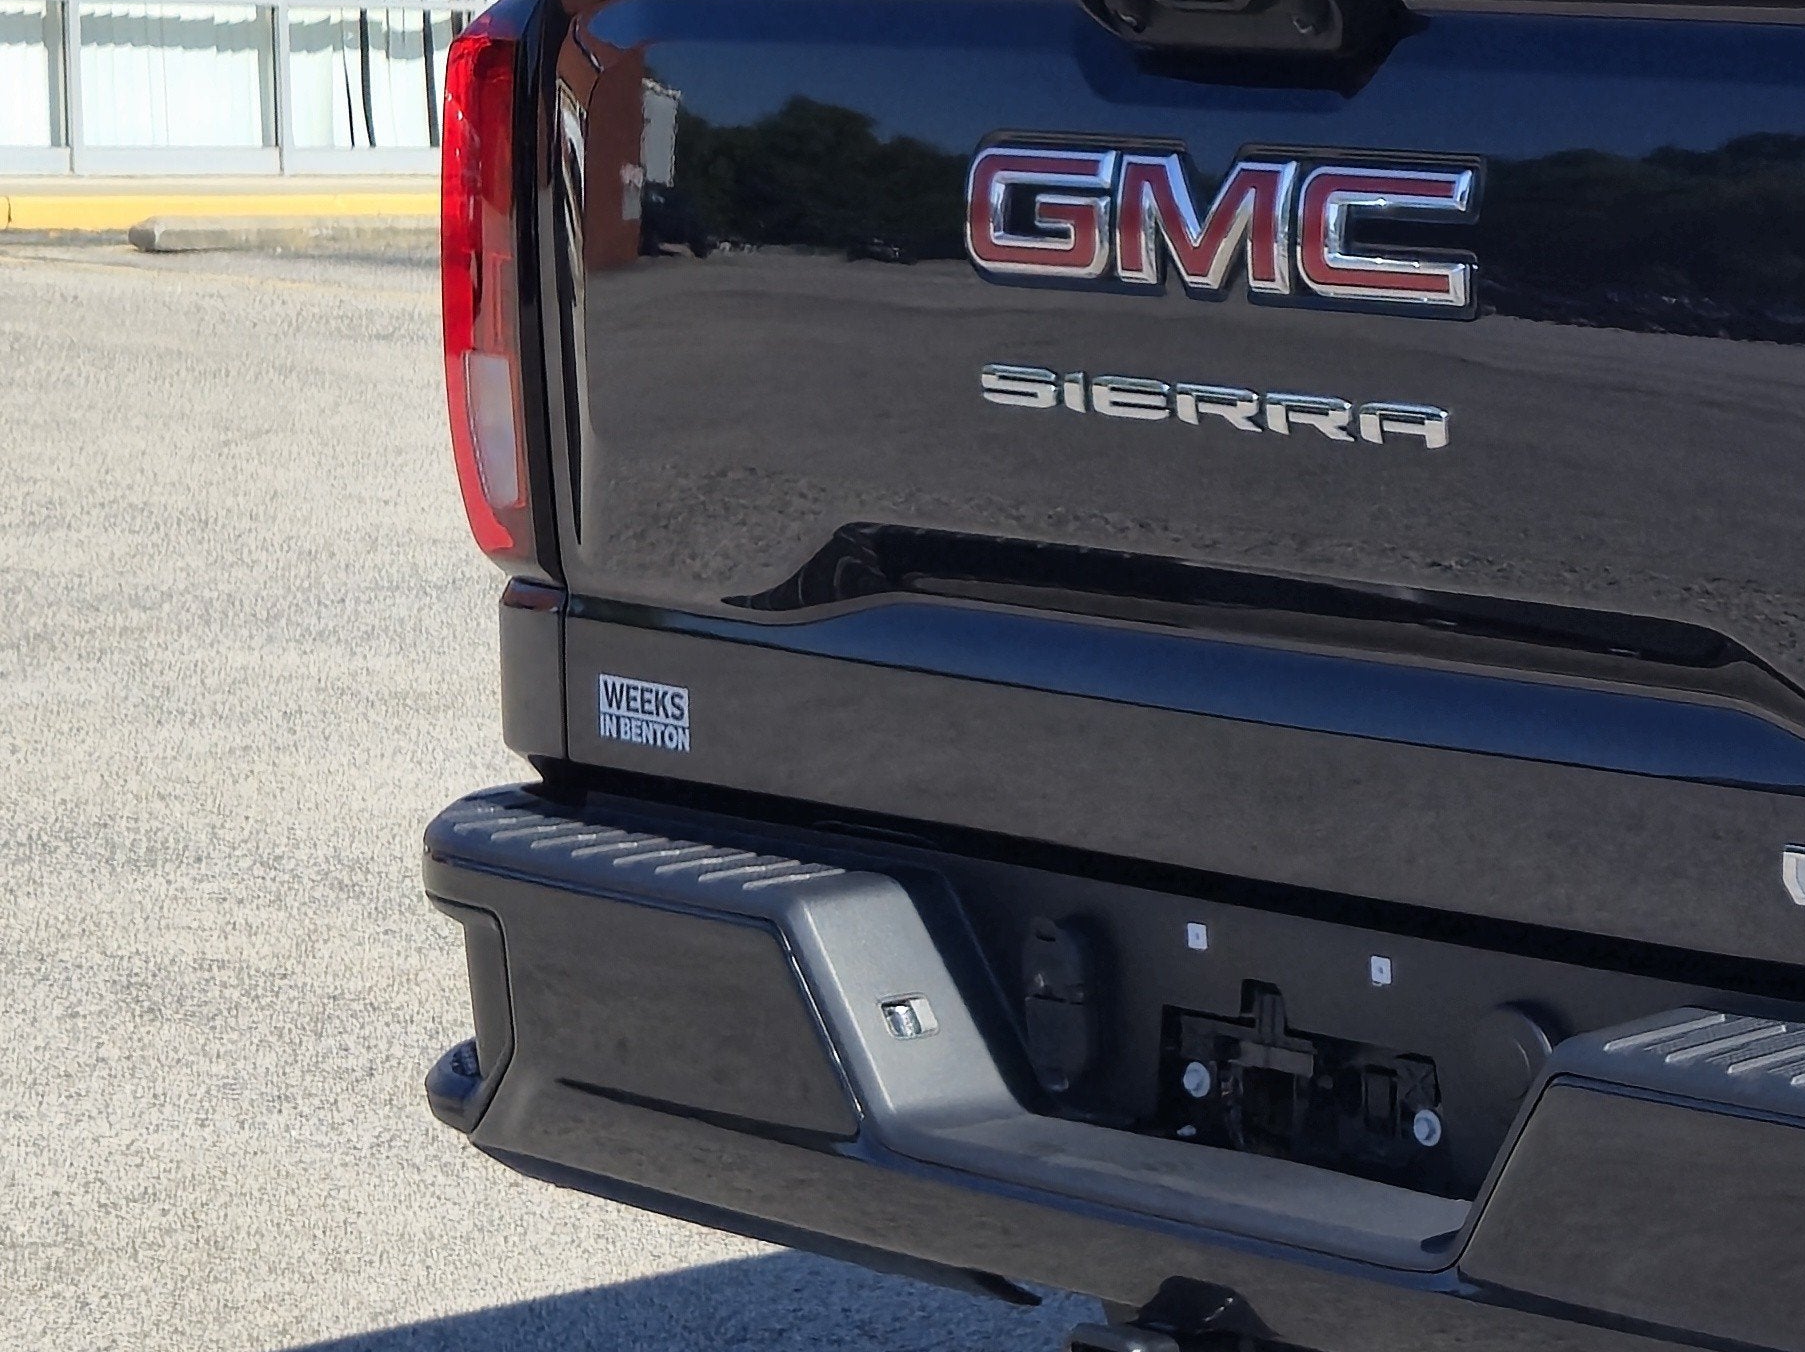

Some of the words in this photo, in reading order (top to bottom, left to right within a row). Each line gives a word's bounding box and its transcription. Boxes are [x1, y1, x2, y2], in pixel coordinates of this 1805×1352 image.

[964, 146, 1478, 308] GMC
[980, 362, 1450, 450] SIERRA
[603, 679, 685, 721] WEEKS
[600, 714, 617, 738] IN
[620, 716, 690, 752] BENTON
